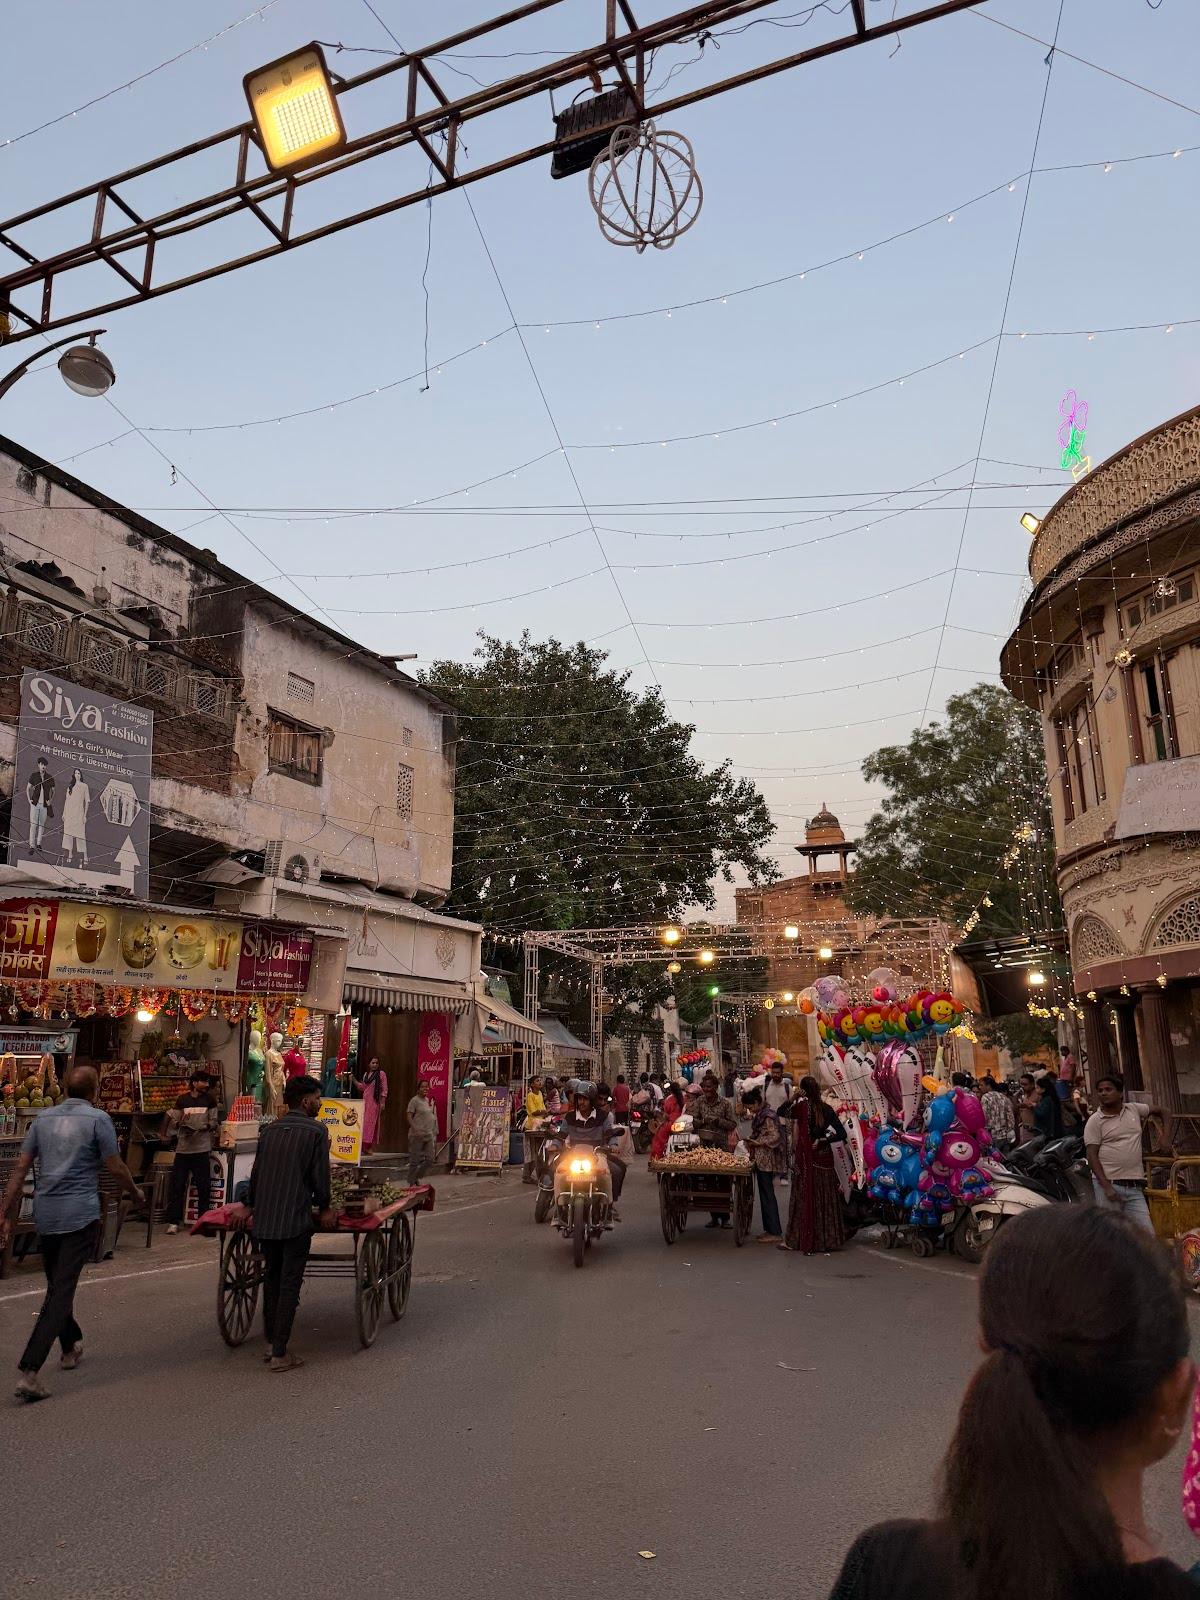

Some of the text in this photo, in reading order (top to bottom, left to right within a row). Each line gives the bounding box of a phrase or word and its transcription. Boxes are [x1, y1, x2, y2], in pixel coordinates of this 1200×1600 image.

[29, 678, 148, 746] Siya Fashion
[52, 747, 77, 761] Ethnic
[79, 753, 85, 763] &
[86, 757, 115, 770] Western
[117, 764, 134, 776] Wear
[54, 733, 124, 760] Men's & Girl's Wear
[243, 929, 283, 964] Siya
[284, 948, 310, 962] Fashion
